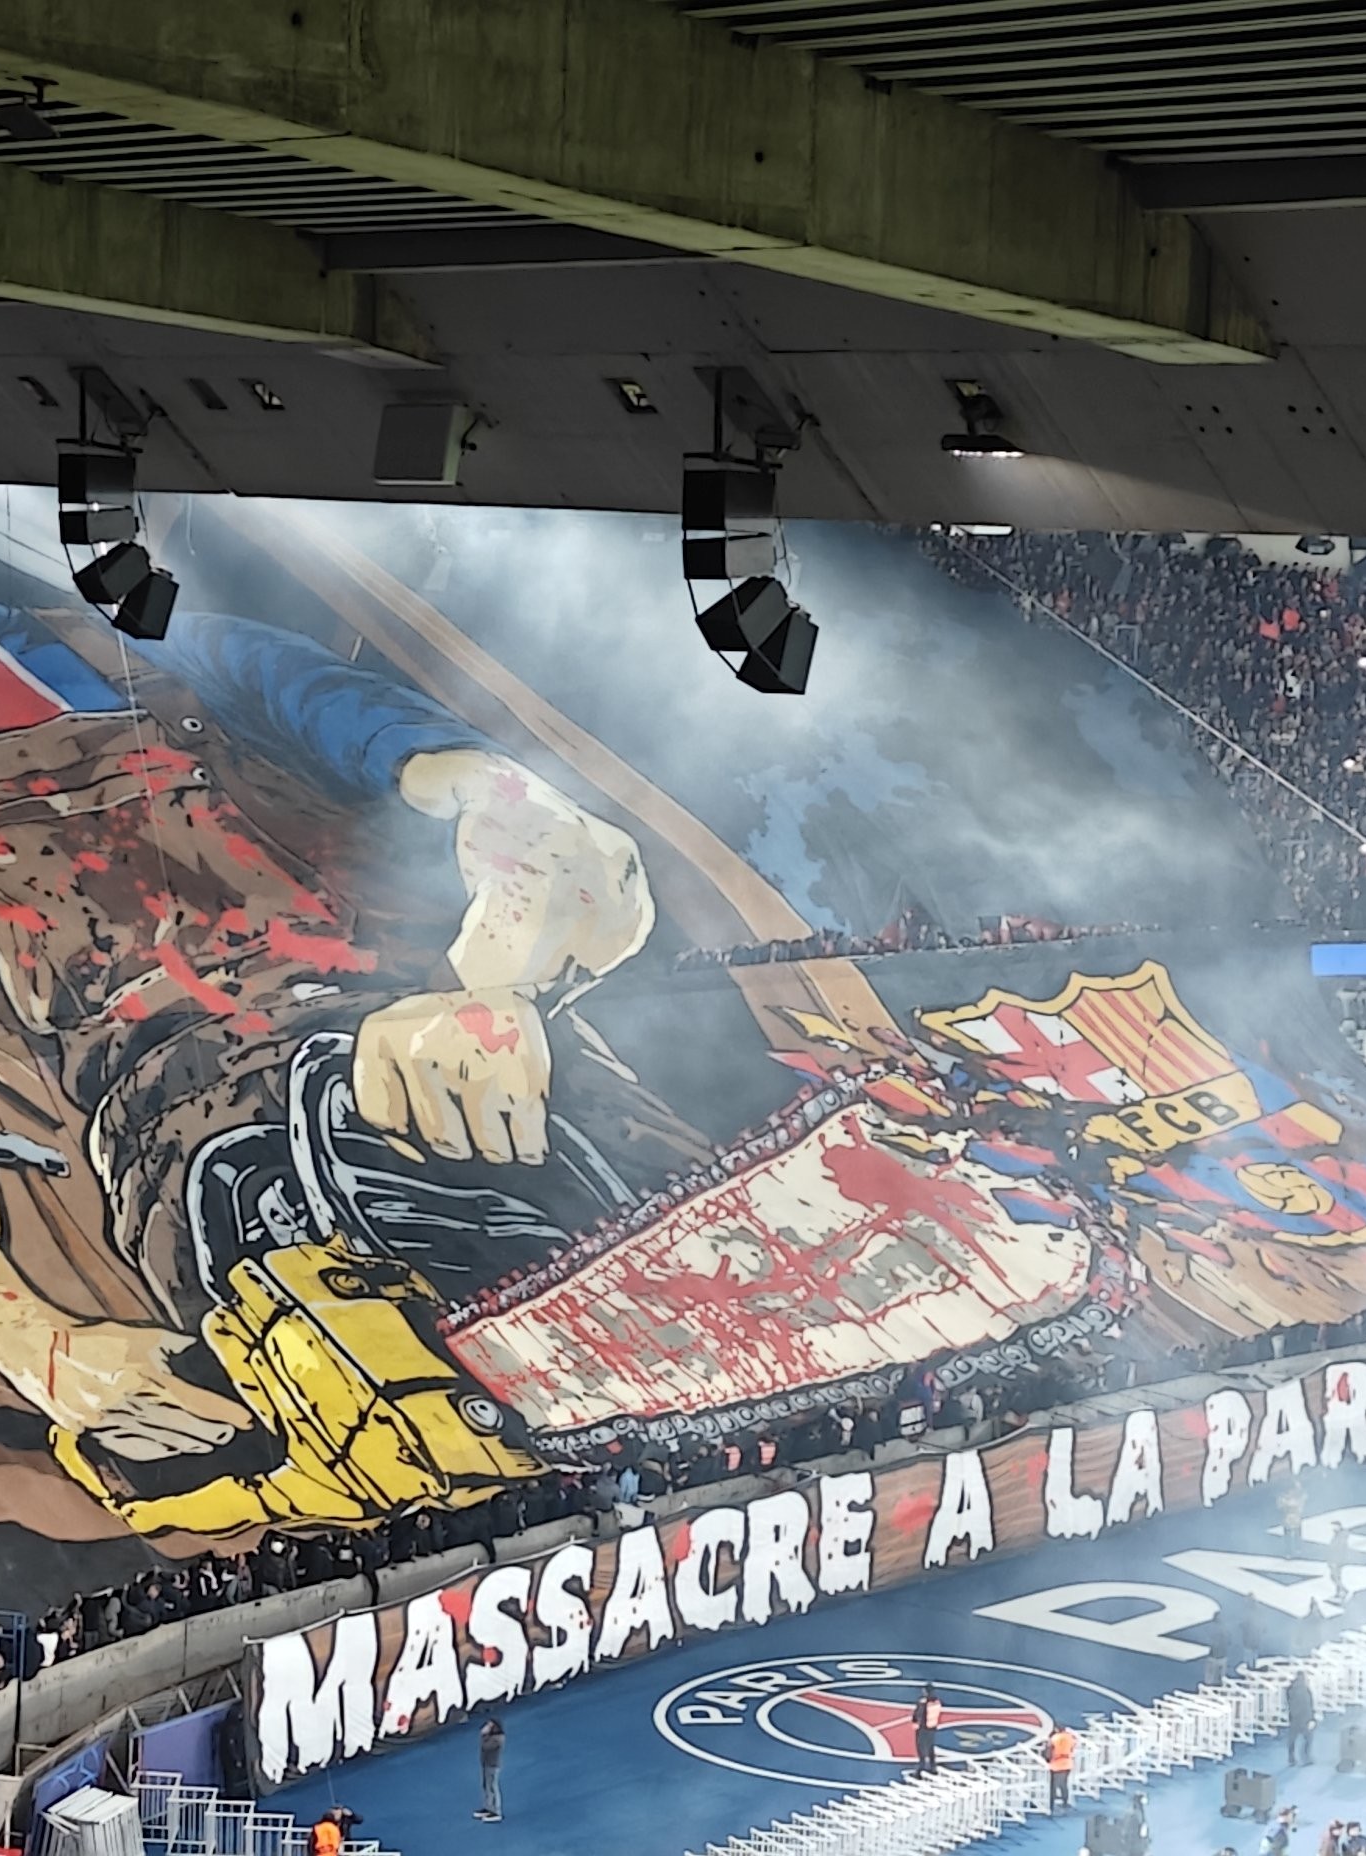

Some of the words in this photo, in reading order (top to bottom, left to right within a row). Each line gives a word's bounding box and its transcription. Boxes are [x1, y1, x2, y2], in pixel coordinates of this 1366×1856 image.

[1116, 1090, 1240, 1148] FCB
[258, 1471, 875, 1785] MASSACRE
[923, 1450, 996, 1570] A
[1045, 1408, 1165, 1541] LA
[675, 1659, 903, 1726] PARIS
